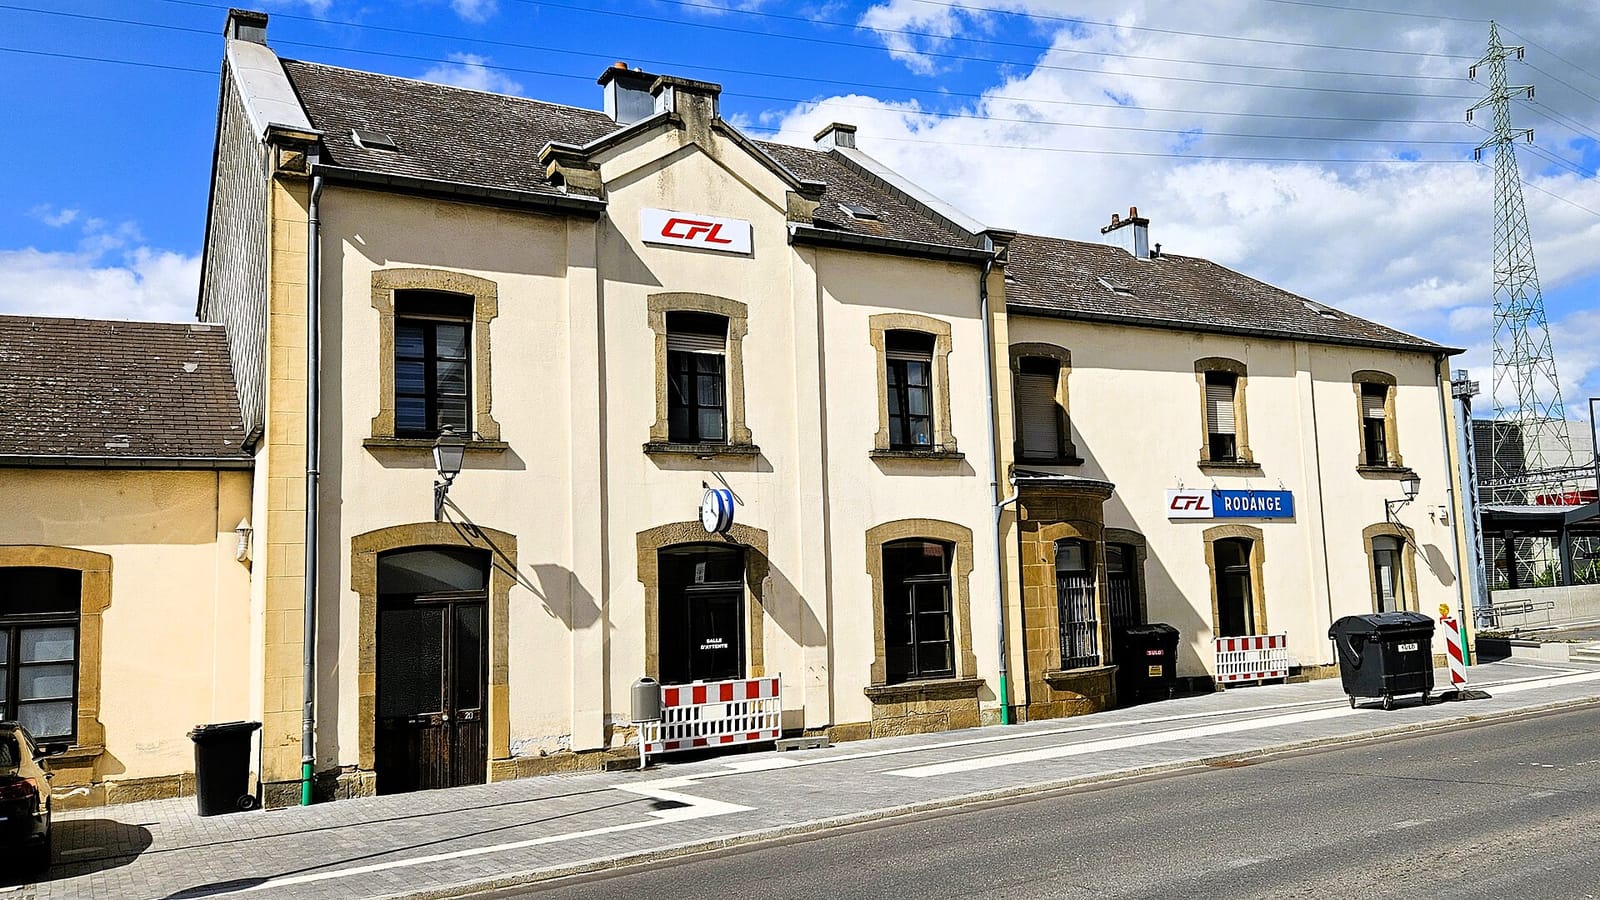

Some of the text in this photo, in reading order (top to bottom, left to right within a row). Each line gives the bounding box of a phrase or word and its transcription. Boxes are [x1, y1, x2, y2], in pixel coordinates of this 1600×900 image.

[661, 218, 733, 244] CFL
[1170, 496, 1281, 511] CFL RODANGE
[464, 711, 474, 720] 20
